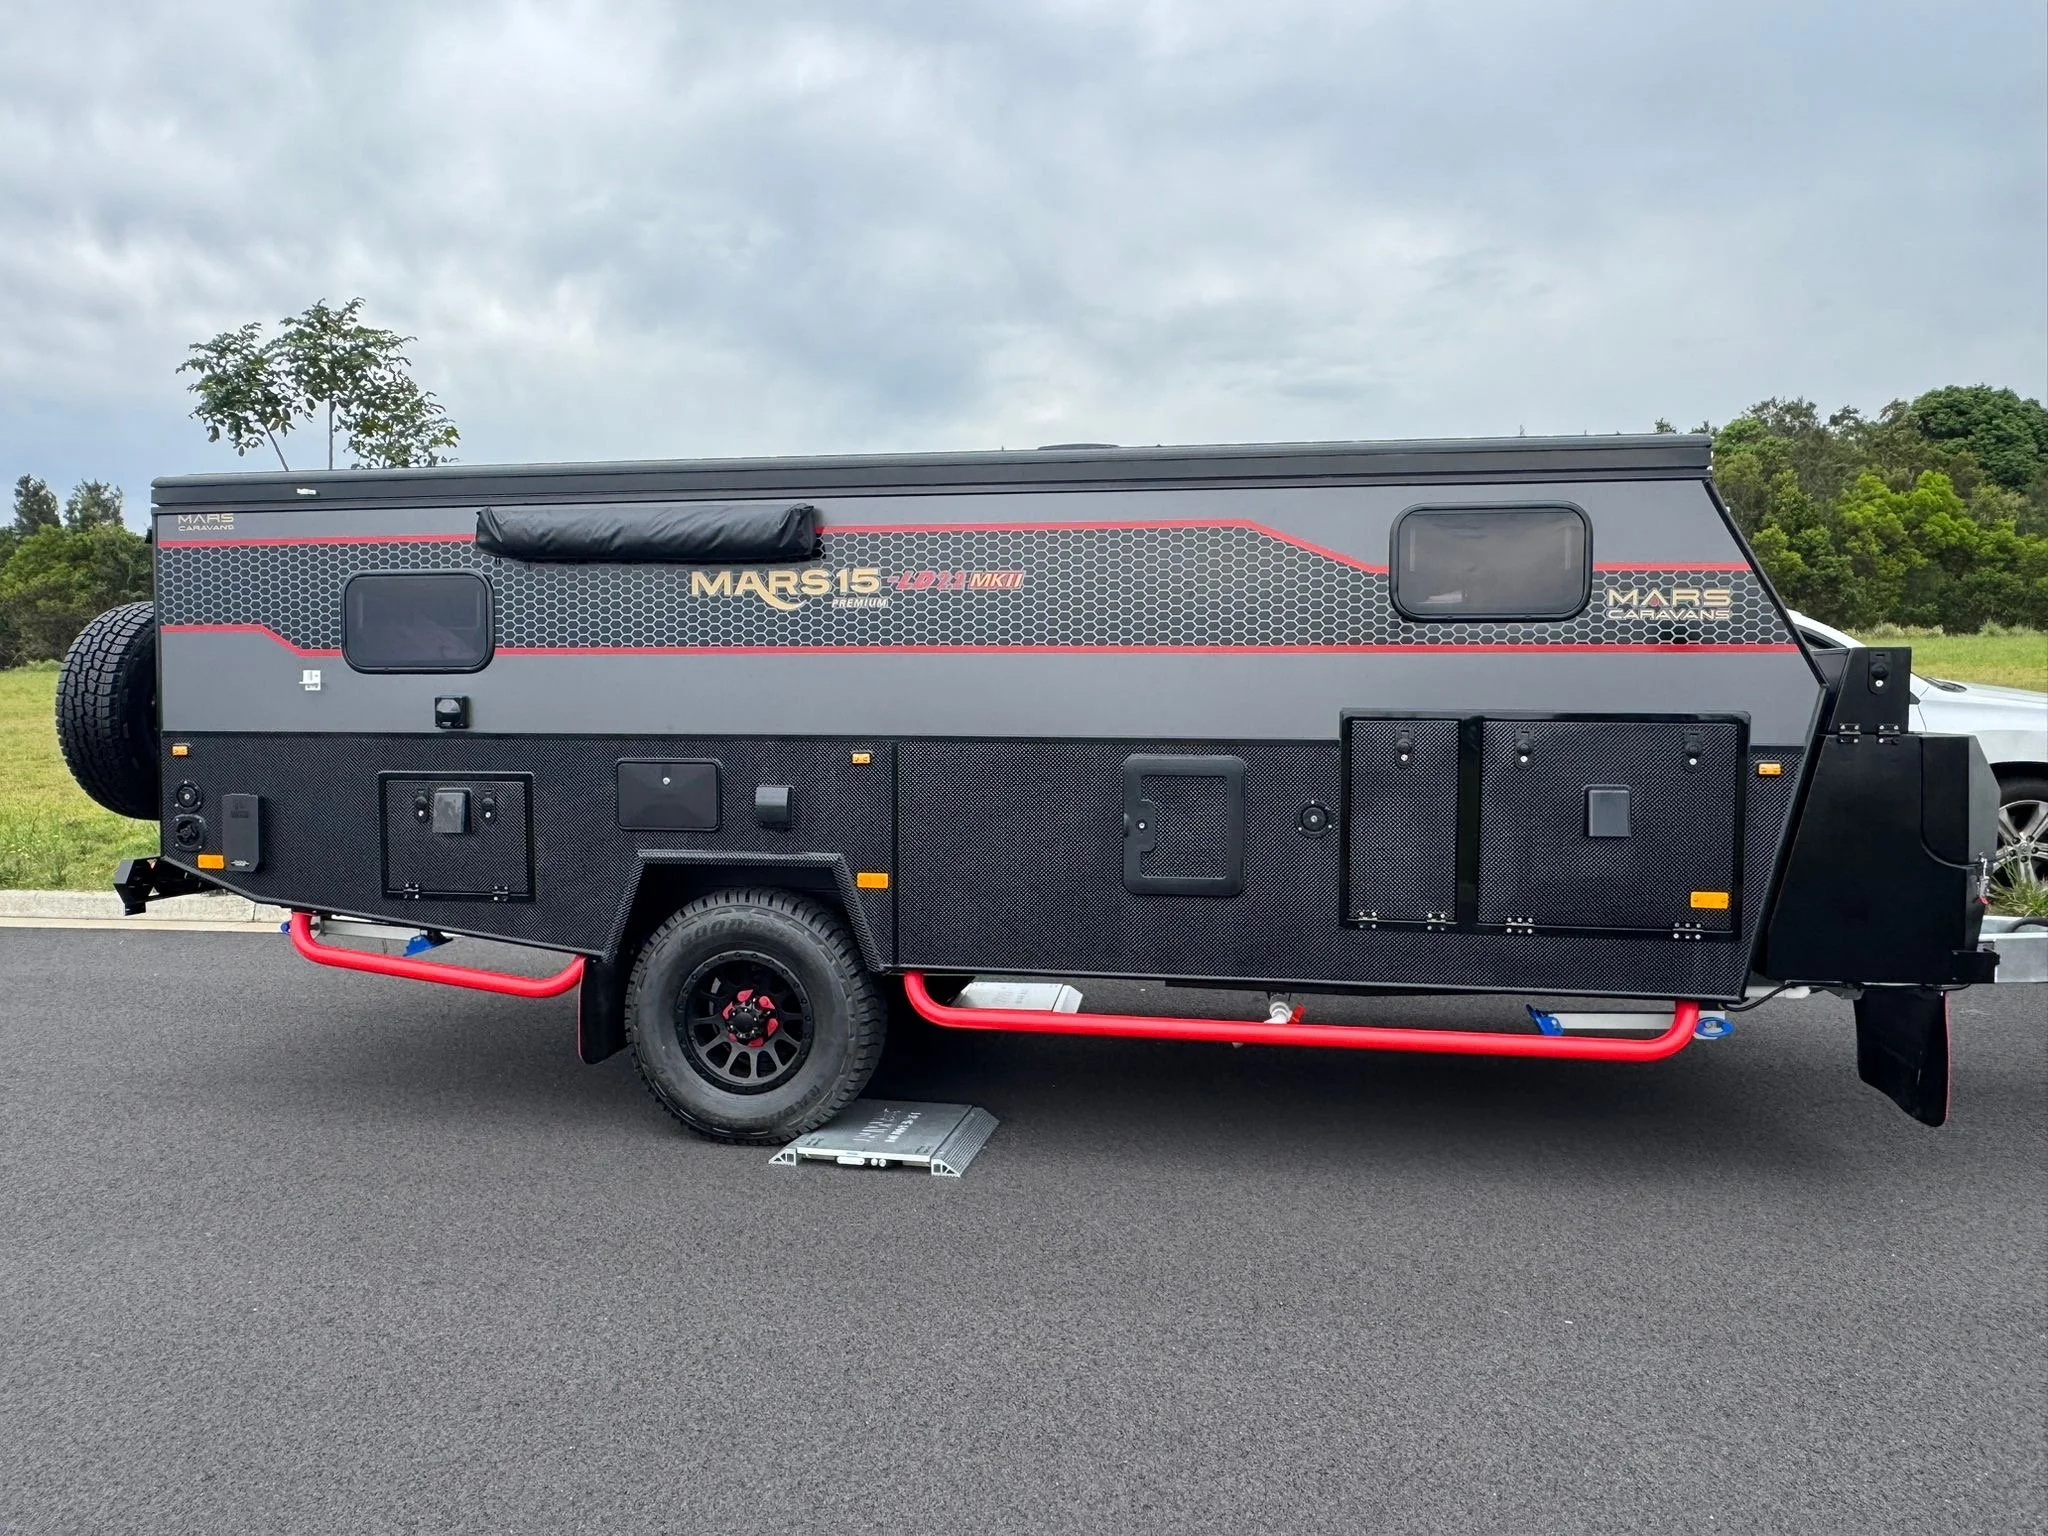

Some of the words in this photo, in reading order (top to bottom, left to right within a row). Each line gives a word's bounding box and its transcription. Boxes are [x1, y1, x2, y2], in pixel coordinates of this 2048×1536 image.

[178, 513, 234, 524] MARS
[178, 524, 235, 532] CARAVANS
[969, 572, 1024, 588] MKII
[1608, 588, 1731, 607] MARS
[831, 598, 889, 609] PREMIUM
[1608, 609, 1731, 620] CARAVANS
